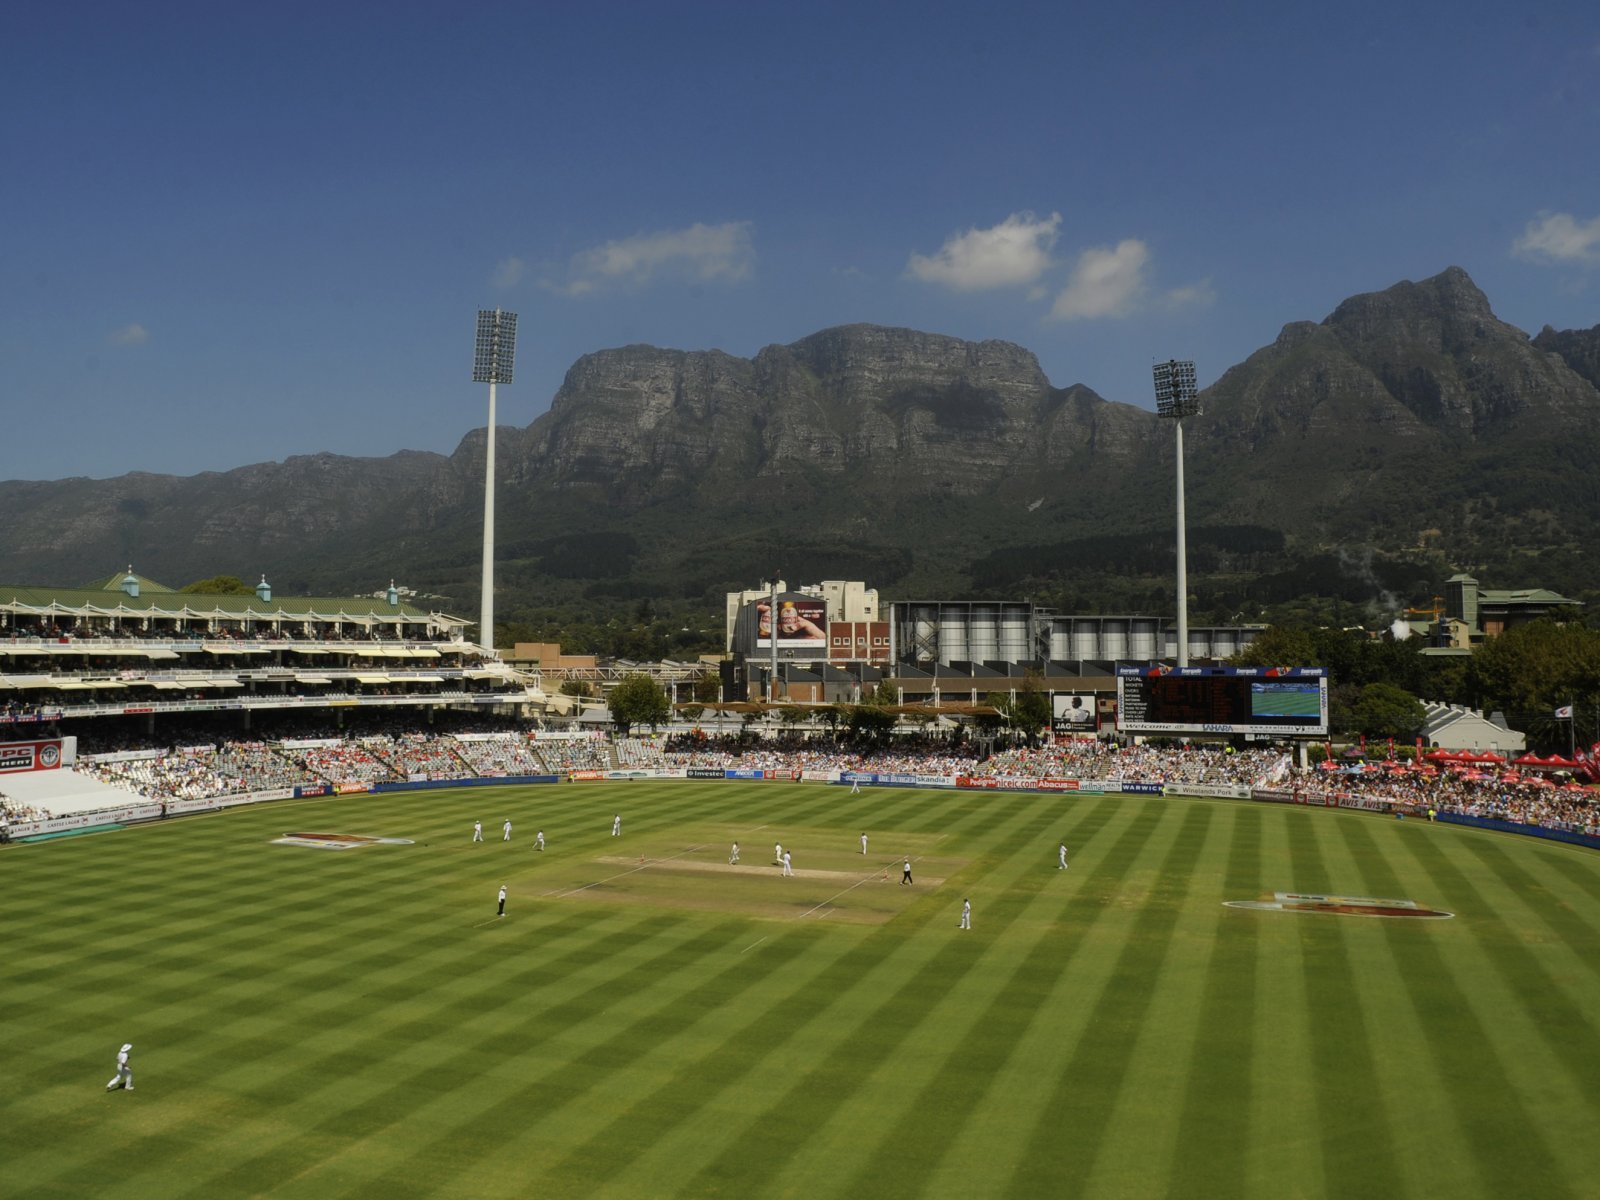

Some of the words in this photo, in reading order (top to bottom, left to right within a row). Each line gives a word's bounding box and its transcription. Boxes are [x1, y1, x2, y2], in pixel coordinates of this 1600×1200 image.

[0, 748, 31, 758] PC
[1039, 780, 1068, 789] Abacus
[1340, 799, 1358, 807] AVIS
[1362, 800, 1380, 809] AVIS
